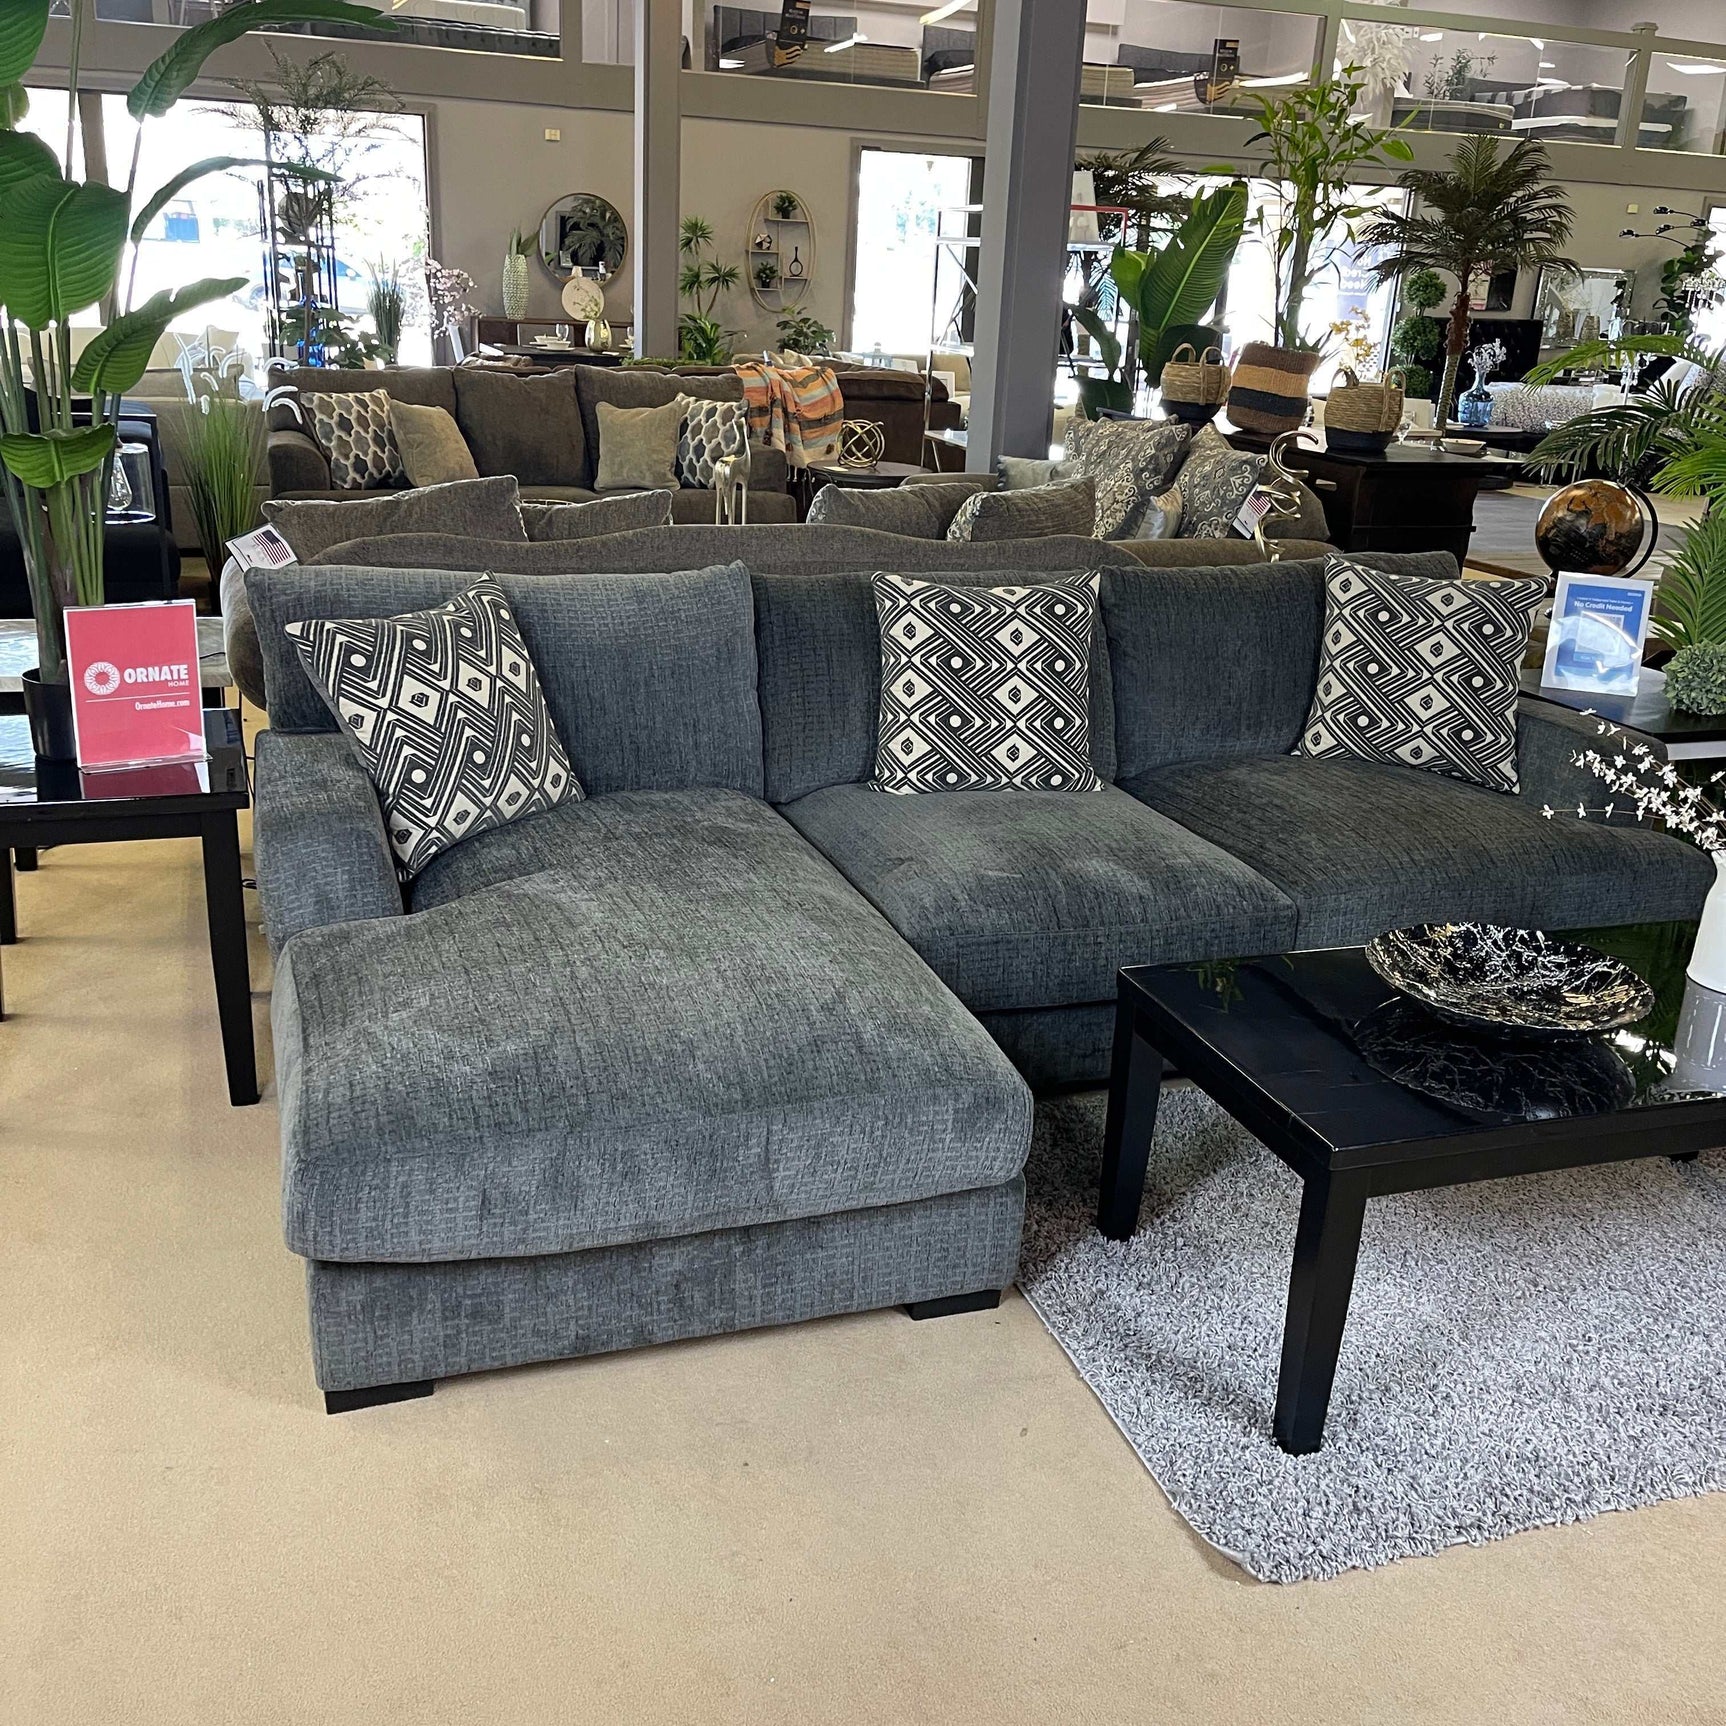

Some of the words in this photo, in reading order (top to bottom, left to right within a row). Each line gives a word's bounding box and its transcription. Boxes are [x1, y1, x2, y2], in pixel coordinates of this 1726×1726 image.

[1585, 602, 1605, 610] Credit
[1606, 604, 1633, 612] Needed
[123, 664, 189, 684] ORNATE
[135, 700, 190, 711] OrnateHome.com
